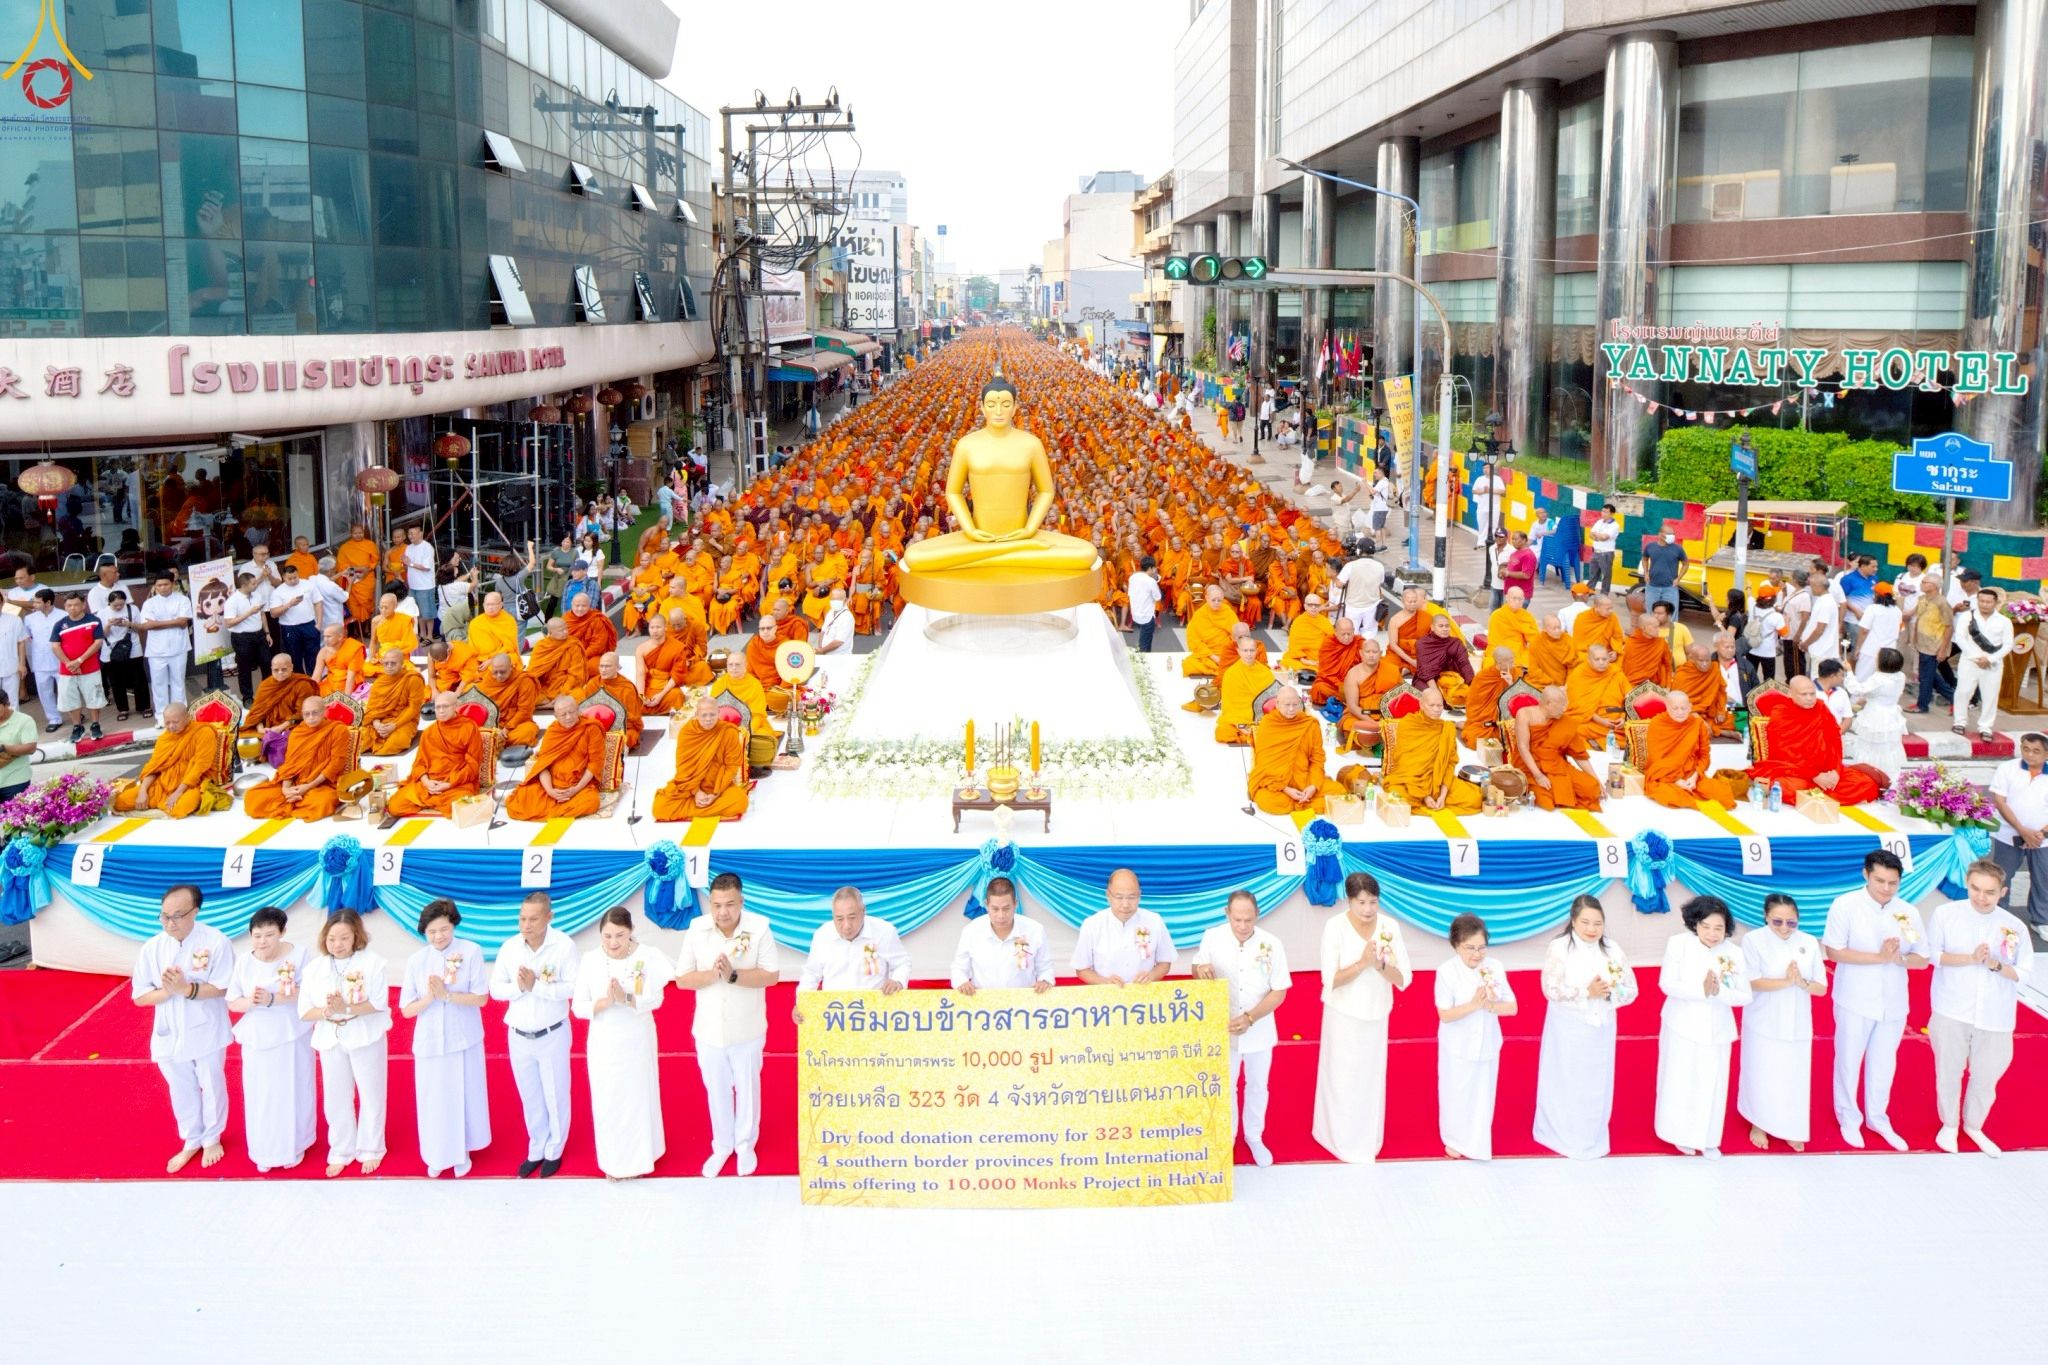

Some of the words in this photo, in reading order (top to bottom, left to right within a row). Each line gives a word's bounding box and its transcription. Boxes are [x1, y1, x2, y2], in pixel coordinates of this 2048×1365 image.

[465, 350, 527, 379] SAKURA
[529, 346, 566, 371] HOTEL
[1601, 343, 1826, 387] YANNATY
[1840, 348, 2029, 394] HOTEL
[1919, 450, 1937, 459] แยก
[1925, 464, 1979, 483] ซากุระ
[1931, 480, 1973, 494] Sakura
[1283, 841, 1297, 862] 6
[1455, 843, 1469, 864] 7
[1606, 844, 1619, 864] 8
[1749, 842, 1762, 862] 9
[1885, 839, 1907, 859] 10
[80, 852, 95, 873] 5
[229, 853, 244, 874] 4
[381, 852, 395, 872] 3
[529, 853, 544, 874] 2
[688, 855, 698, 875] 1
[822, 988, 1205, 1032] พิธีมอบข้าวสารอาหารแห้ง
[805, 1049, 956, 1068] ในโครงการตักบาตรพระ
[962, 1050, 1023, 1069] 10,000
[1029, 1047, 1054, 1074] รูป
[1059, 1046, 1115, 1066] หาดใหญ่
[1119, 1045, 1179, 1062] นานาชาติ
[1183, 1040, 1203, 1059] ปีที่
[1207, 1045, 1222, 1057] 22
[808, 1085, 901, 1108] ช่วยเหลือ
[908, 1090, 946, 1108] 323
[954, 1084, 980, 1108] วัด
[988, 1090, 1000, 1106] 4
[1007, 1071, 1222, 1107] จังหวัดชายแดนภาคใต้
[821, 1129, 852, 1147] Dry
[857, 1130, 895, 1145] food
[900, 1130, 973, 1145] donation
[979, 1132, 1059, 1146] ceremony
[1065, 1128, 1089, 1142] for
[1095, 1126, 1133, 1141] 323
[1140, 1123, 1203, 1140] temples
[817, 1155, 829, 1168] 4
[836, 1155, 908, 1168] southern
[914, 1155, 969, 1169] border
[975, 1154, 1054, 1171] provinces
[1060, 1152, 1099, 1166] from
[1105, 1147, 1209, 1165] International
[809, 1177, 847, 1191] alms
[853, 1177, 917, 1194] offering
[923, 1179, 939, 1191] to
[947, 1177, 1016, 1191] 10.000
[1023, 1176, 1077, 1191] Monks
[1083, 1174, 1141, 1192] Project
[1147, 1174, 1162, 1188] in
[1168, 1171, 1224, 1187] HatYai
